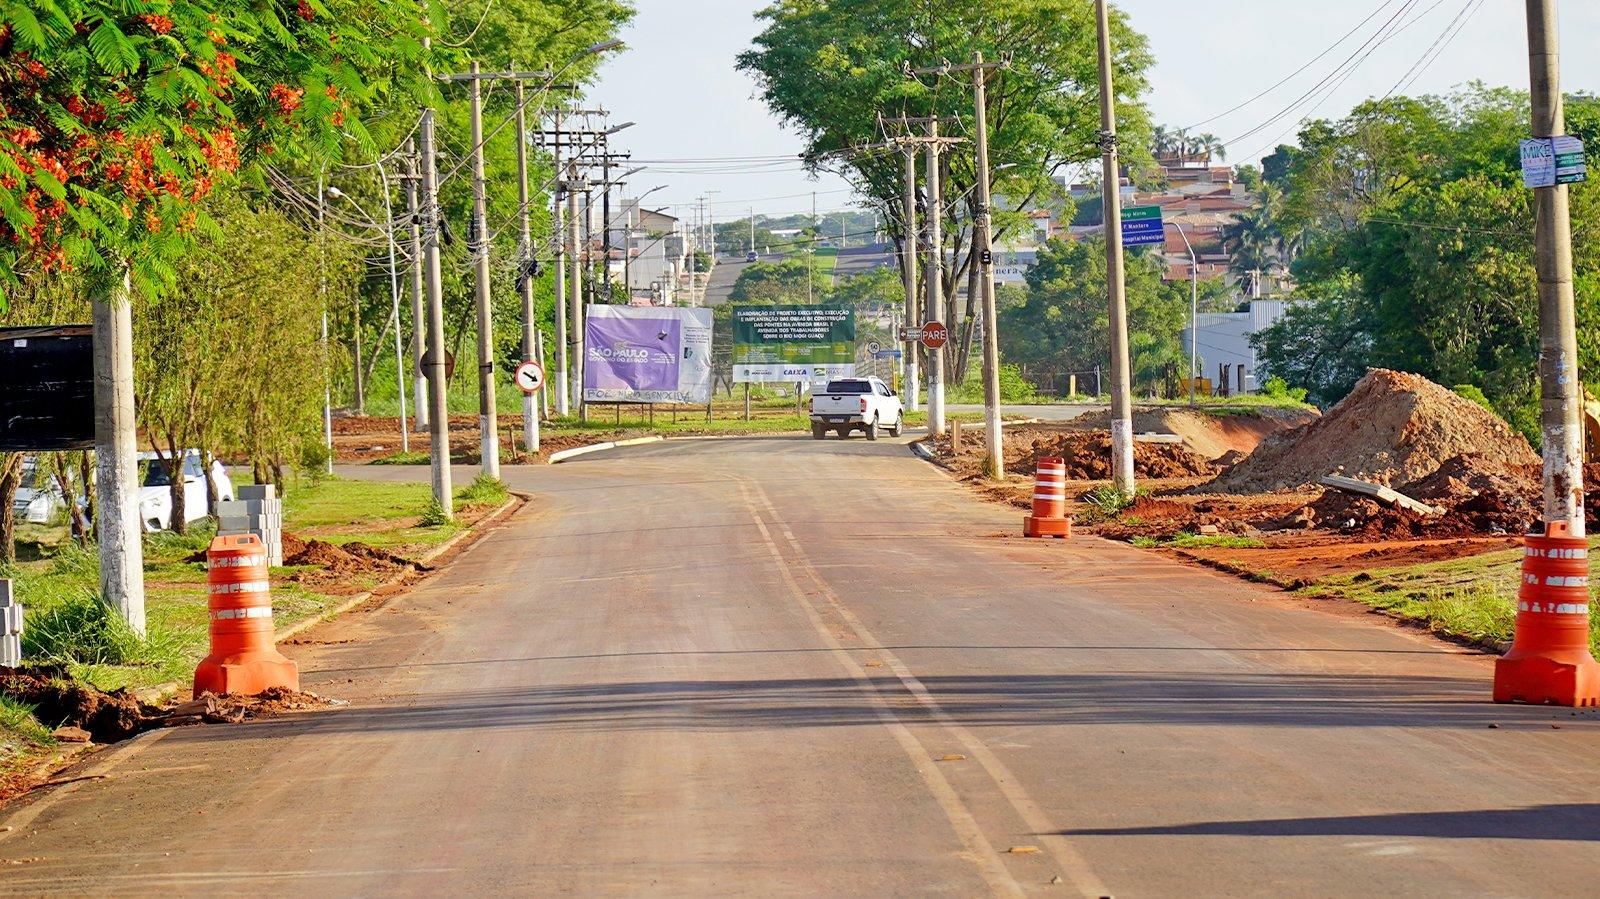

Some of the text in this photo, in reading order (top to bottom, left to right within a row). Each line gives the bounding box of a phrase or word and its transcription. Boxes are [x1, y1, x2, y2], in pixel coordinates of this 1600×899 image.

[922, 330, 947, 340] PARE
[589, 346, 648, 357] SÃO PAULO
